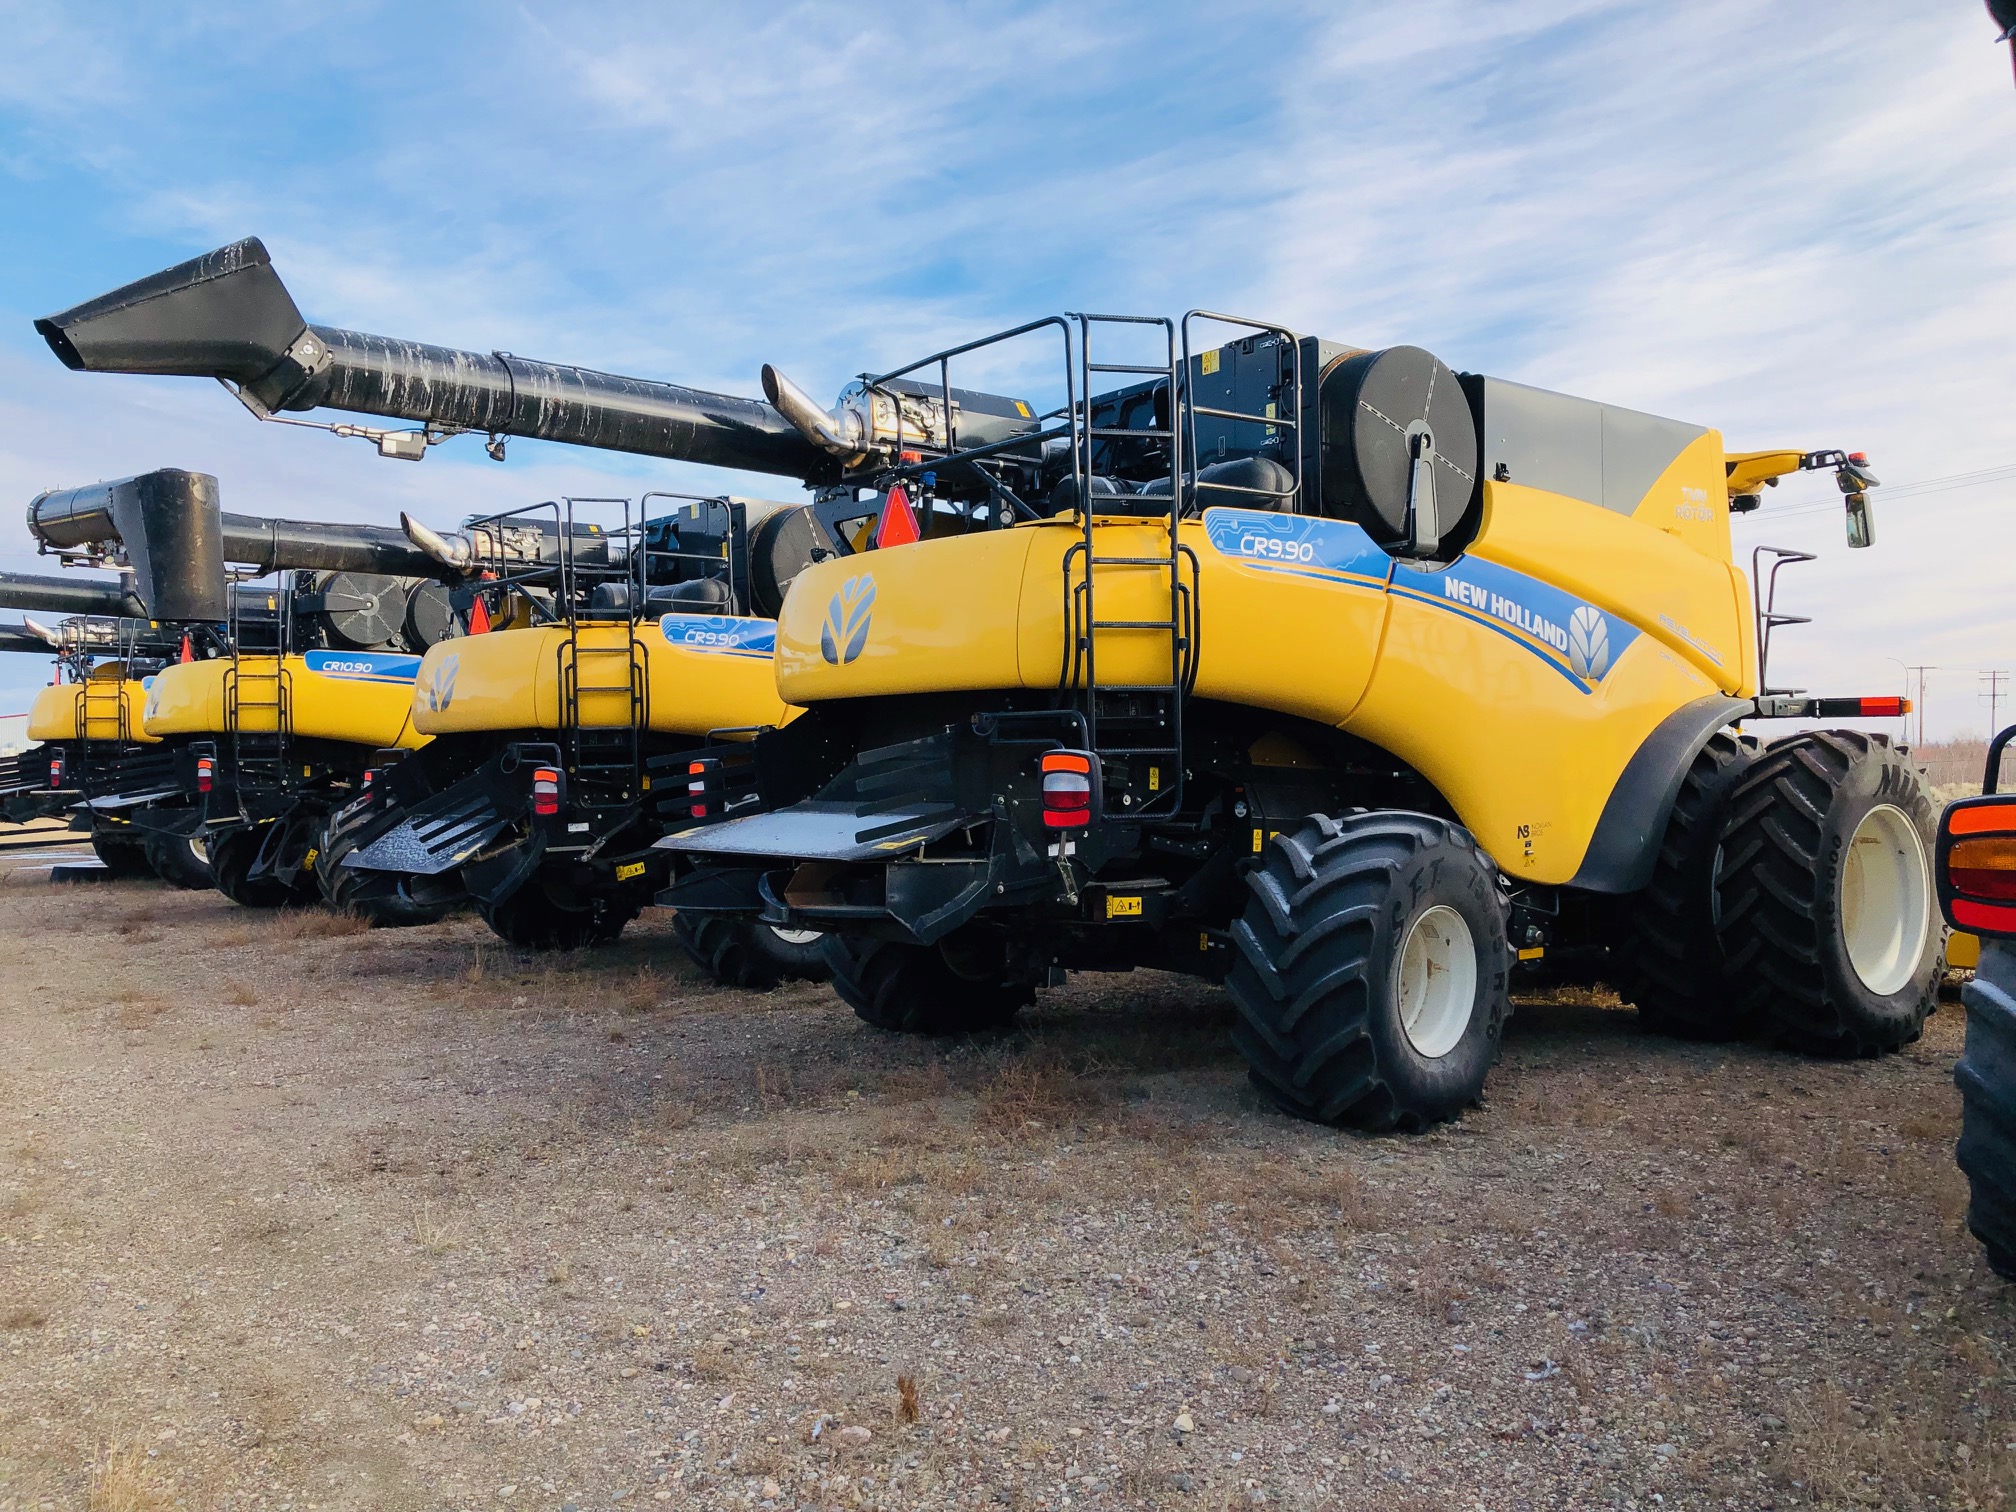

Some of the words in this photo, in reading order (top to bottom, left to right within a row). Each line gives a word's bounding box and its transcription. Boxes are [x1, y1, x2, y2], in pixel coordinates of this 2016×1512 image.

[1675, 503, 1714, 522] ROTOR
[1240, 535, 1314, 562] CR9.90
[1445, 576, 1488, 611] NEW
[1491, 593, 1568, 652] HOLLAND
[684, 630, 740, 647] CR9.90
[1659, 613, 1725, 664] REVELATION
[322, 661, 373, 673] CR10.90
